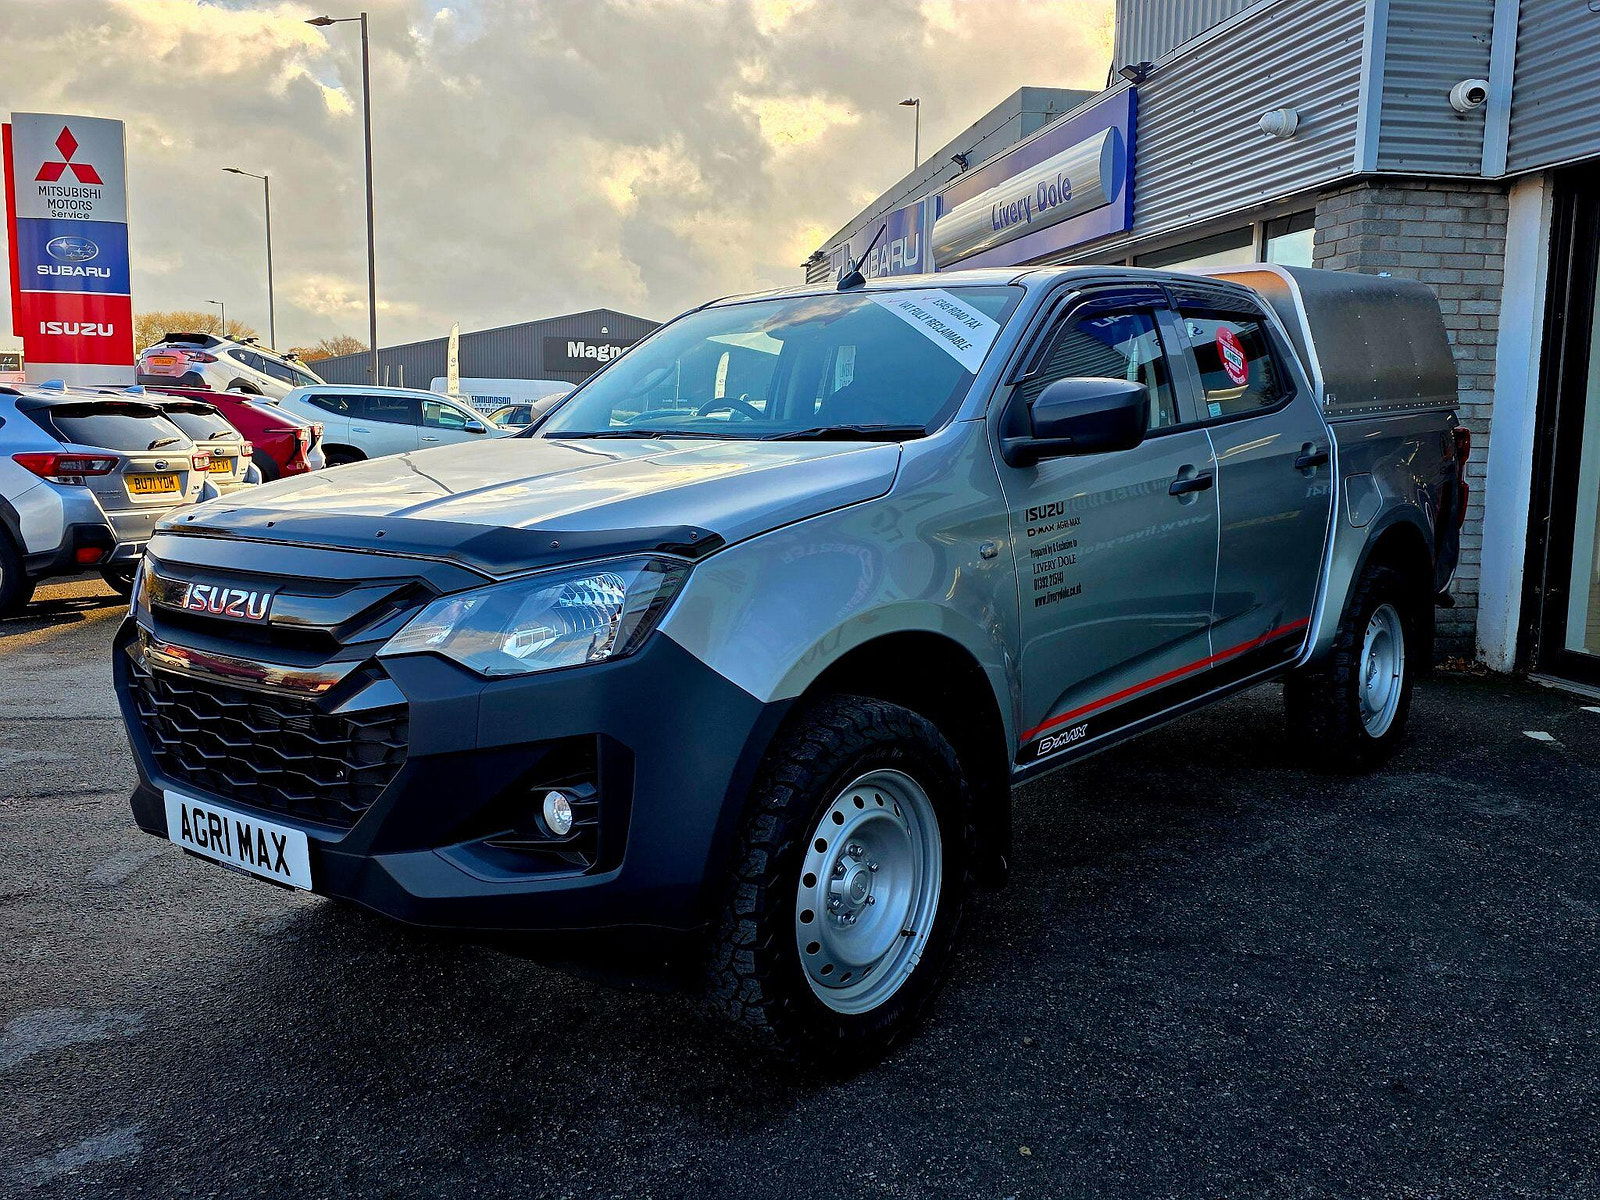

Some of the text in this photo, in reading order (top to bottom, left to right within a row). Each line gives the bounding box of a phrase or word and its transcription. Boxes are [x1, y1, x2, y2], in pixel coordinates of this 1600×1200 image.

[38, 186, 101, 199] MITSUBISHI
[992, 172, 1072, 231] Livery Dole
[48, 199, 93, 211] MOTORS
[51, 210, 90, 220] Service
[37, 265, 111, 277] SUBARU
[947, 306, 971, 321] ROAD
[962, 317, 984, 330] TAX
[39, 321, 114, 337] ISUZU
[908, 306, 932, 322] FULLY
[924, 318, 973, 352] RECLAIMABLE
[1025, 501, 1065, 522] ISUZU
[1032, 554, 1077, 574] LIVERY DOLE
[182, 582, 271, 620] ISUZU
[181, 802, 291, 877] AGRI MAX
